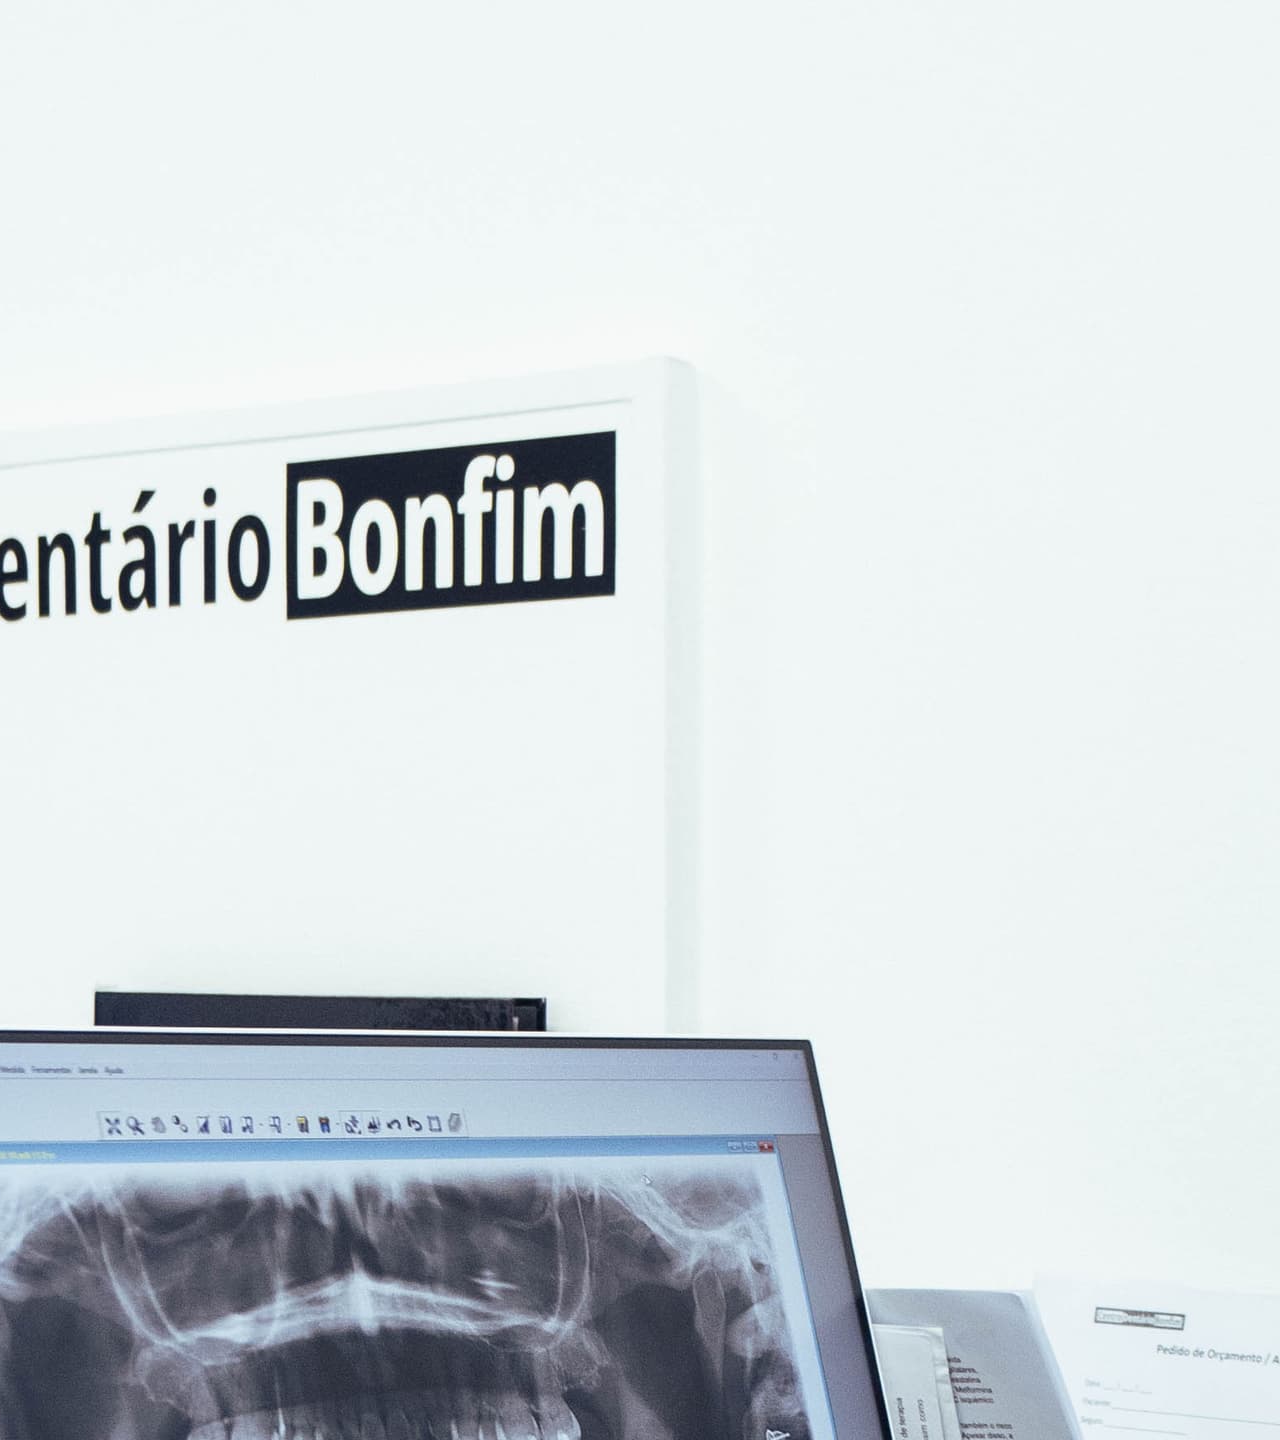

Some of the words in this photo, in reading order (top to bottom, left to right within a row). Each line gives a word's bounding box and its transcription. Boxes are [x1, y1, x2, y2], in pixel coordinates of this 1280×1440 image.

[296, 454, 605, 600] Bonfim
[1156, 1343, 1190, 1357] Pedido
[1193, 1348, 1205, 1359] de
[1207, 1348, 1263, 1364] Orçamento
